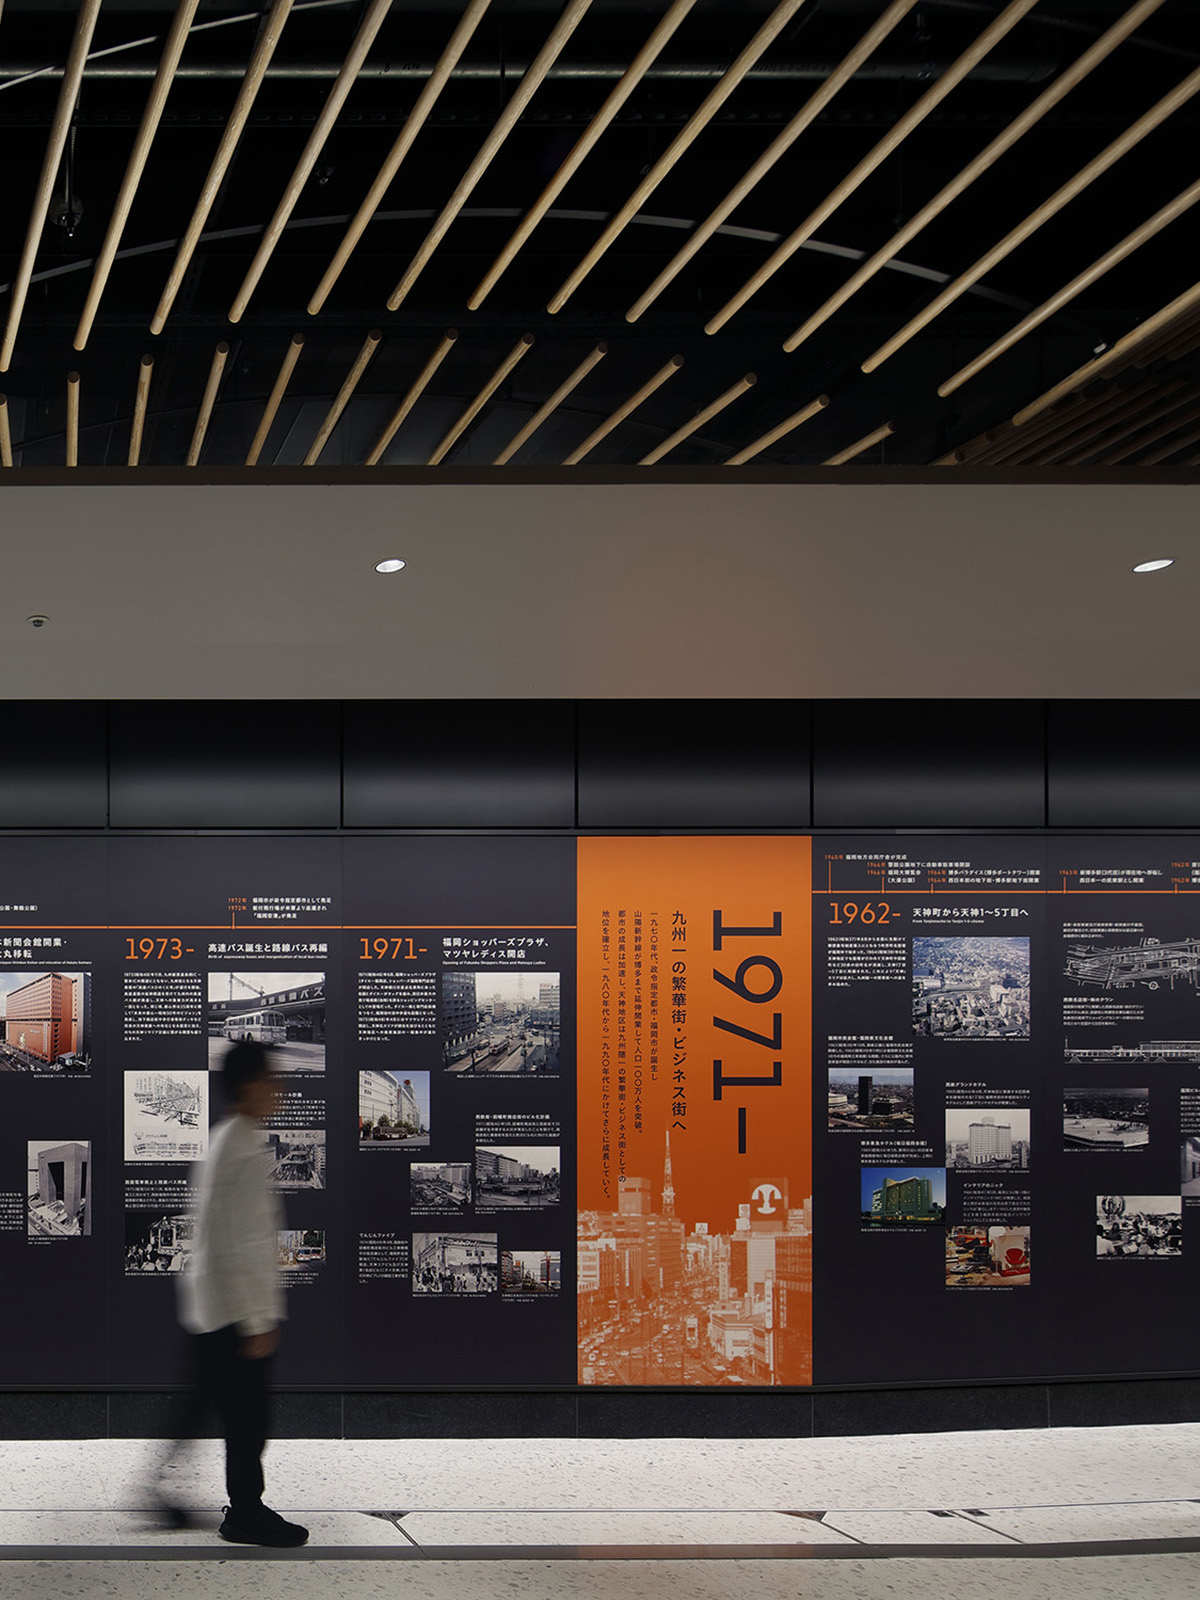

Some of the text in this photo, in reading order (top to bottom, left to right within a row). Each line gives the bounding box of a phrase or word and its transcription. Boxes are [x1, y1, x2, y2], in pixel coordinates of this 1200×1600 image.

[830, 903, 901, 924] 1962-
[126, 938, 194, 959] 1973-
[208, 943, 327, 952] 高速バス誕生と路線バス再編
[360, 938, 427, 959] 1971-
[443, 949, 525, 958] マツヤレディス開店
[672, 911, 686, 1130] 九州一の繁華街・ビジネス街へ
[713, 909, 783, 1154] 1971-
